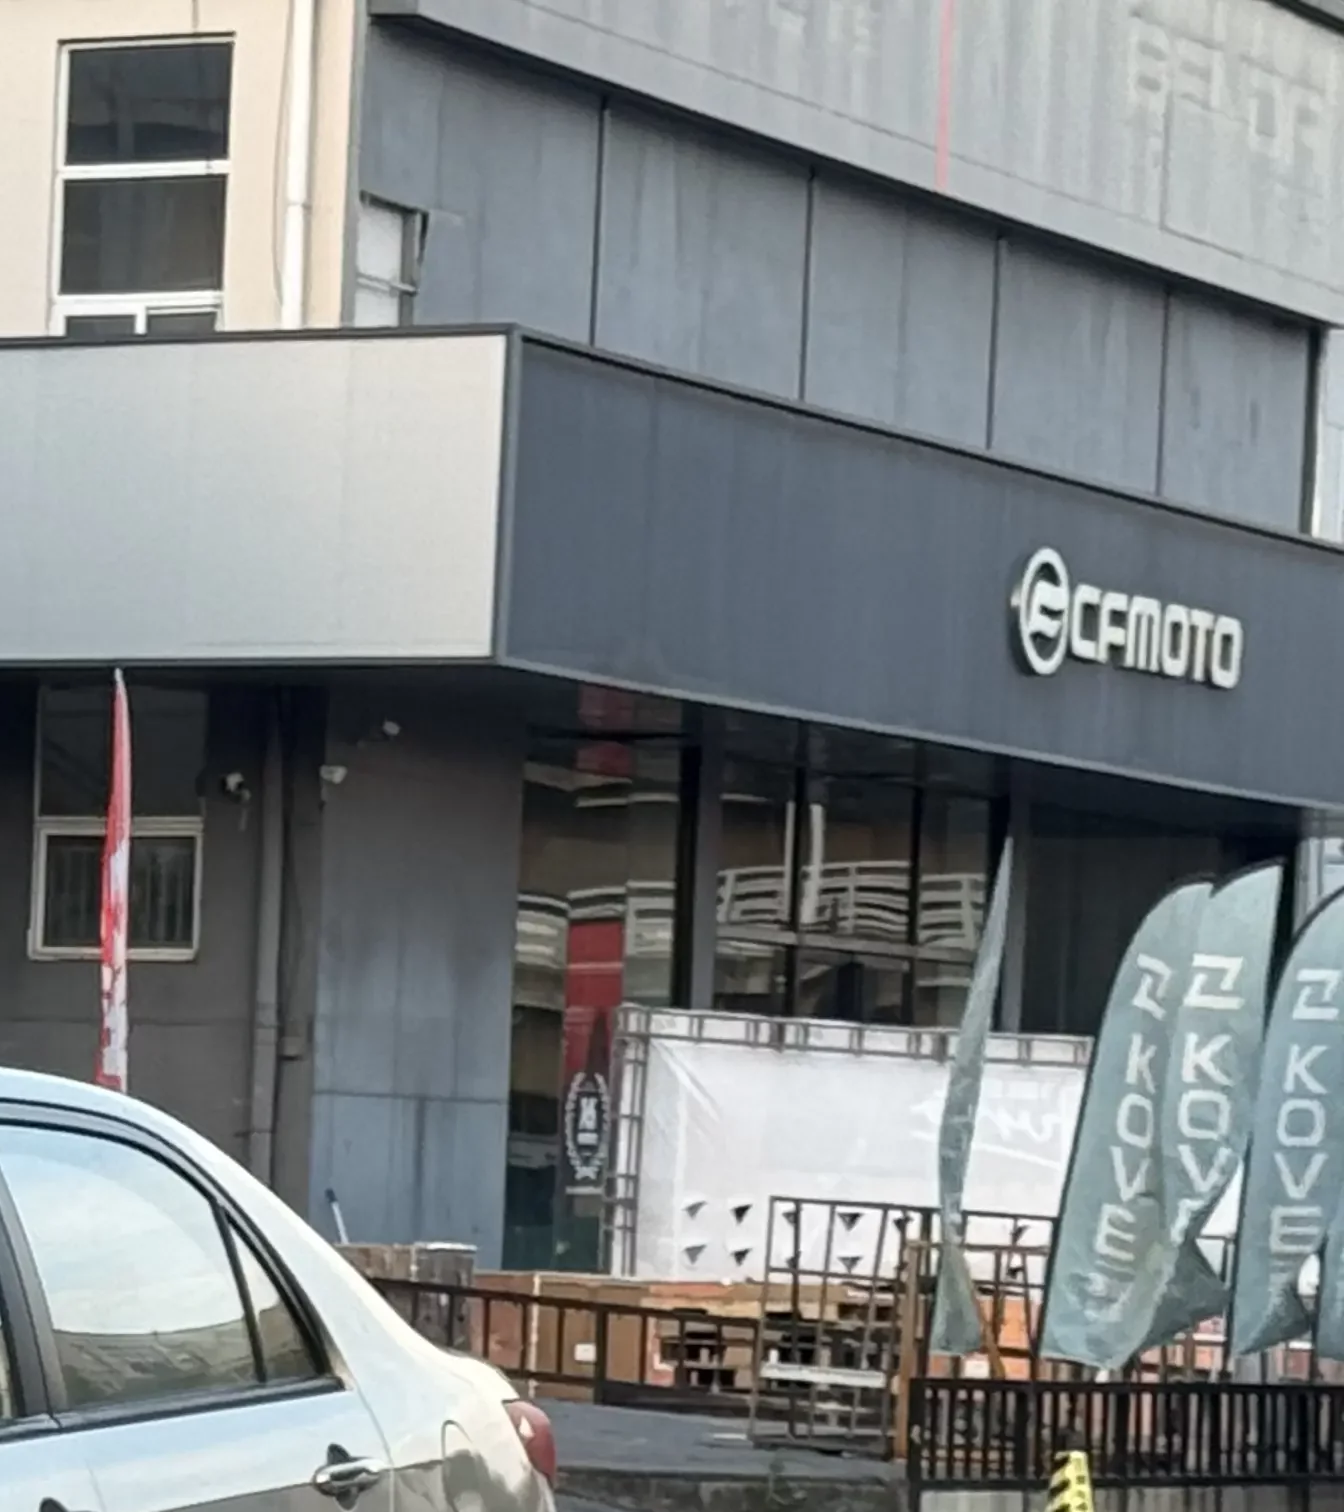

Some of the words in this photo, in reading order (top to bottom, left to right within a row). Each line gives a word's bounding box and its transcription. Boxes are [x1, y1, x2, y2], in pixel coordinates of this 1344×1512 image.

[1070, 583, 1244, 690] CFMOTO
[1095, 1032, 1159, 1262] KOVE
[1268, 1044, 1329, 1254] KOVE
